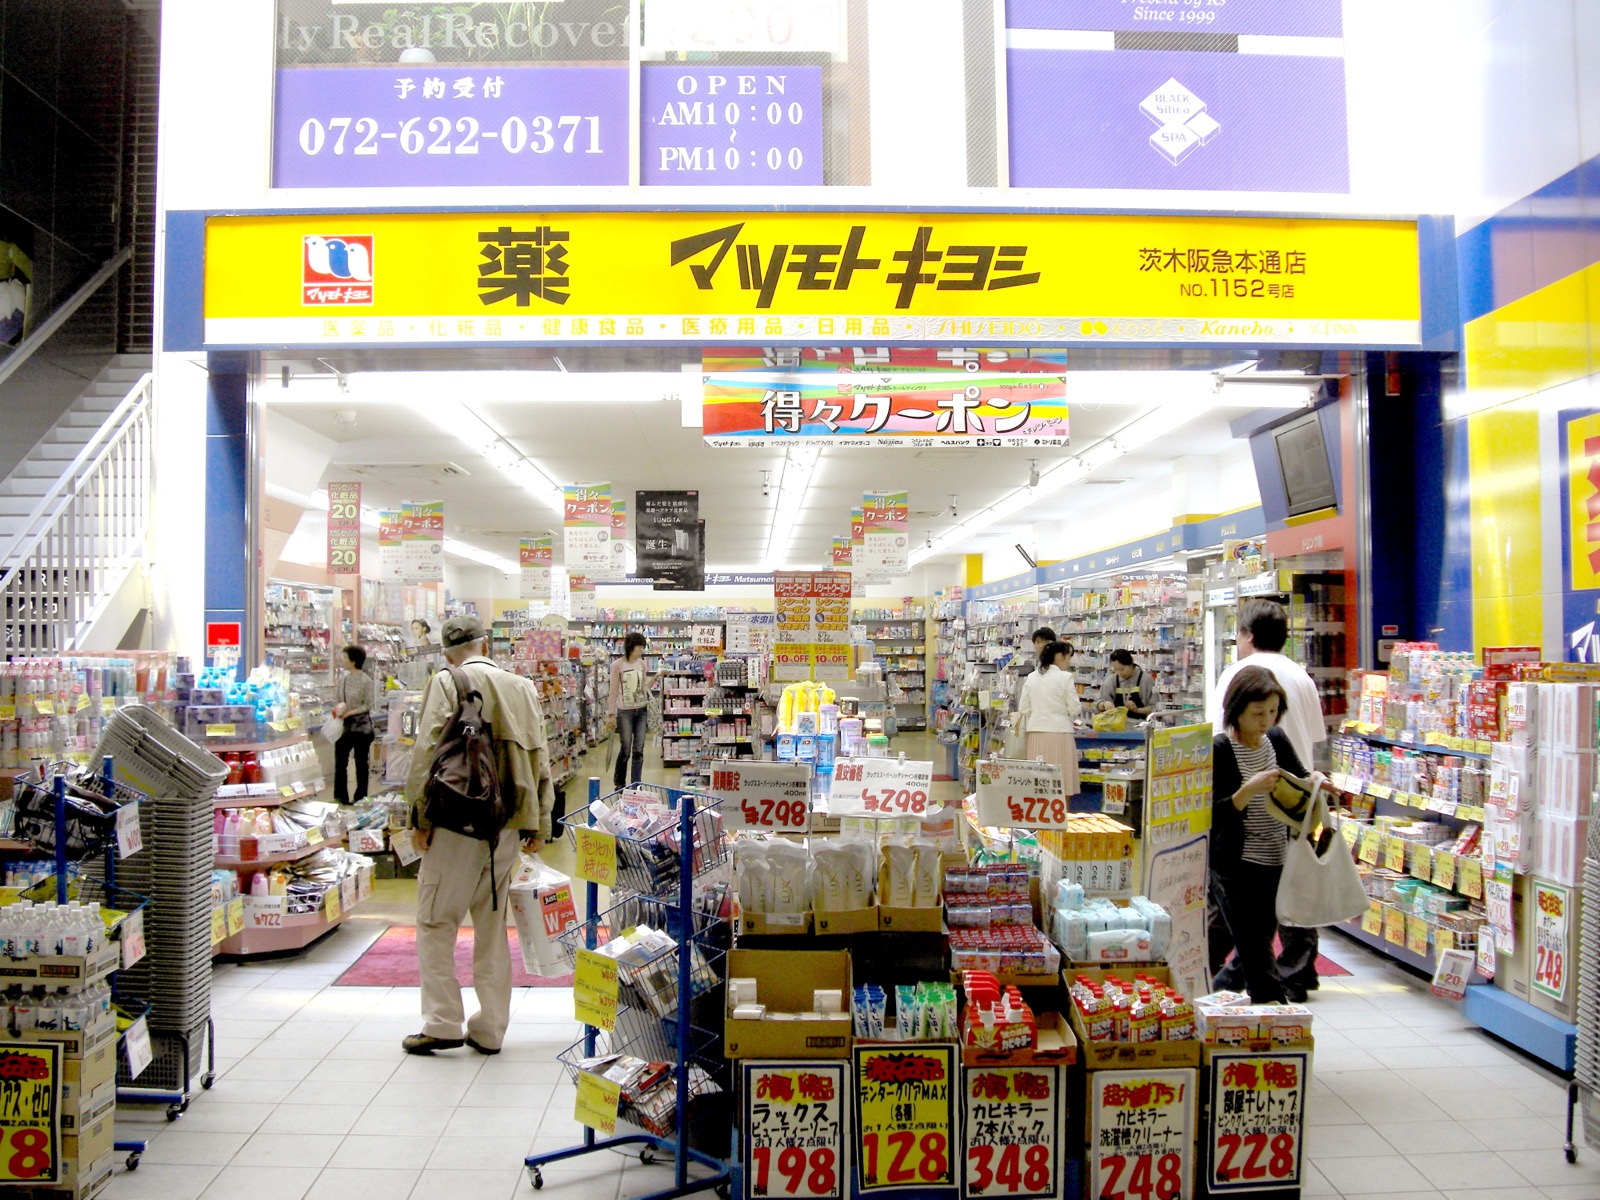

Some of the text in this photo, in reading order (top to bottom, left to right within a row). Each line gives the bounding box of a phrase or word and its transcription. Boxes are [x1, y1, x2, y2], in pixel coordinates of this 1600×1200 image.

[1133, 6, 1216, 25] Since 1999
[394, 75, 506, 100] 予約受付
[676, 75, 788, 96] OPEN
[1154, 93, 1191, 104] BLACK
[1155, 103, 1191, 115] Silica
[298, 114, 604, 156] 072-622-0371
[1160, 131, 1188, 144] SPA
[477, 222, 1040, 308] 薬 マツモトキヨシ
[1138, 247, 1308, 275] 茨木阪急本通店
[306, 287, 371, 303] マツモトキヨシ
[322, 318, 396, 337] 医薬品
[429, 318, 503, 337] 化粧品
[543, 318, 645, 336] 健康食品
[681, 318, 784, 336] 医療用品
[817, 318, 891, 336] 日用品
[936, 319, 1043, 336] SHISEIDO
[1199, 319, 1275, 336] Kanebo
[759, 385, 1031, 435] 得々クーポン
[575, 488, 600, 502] 得々
[874, 497, 897, 510] 得々
[330, 503, 358, 519] 20
[566, 503, 610, 514] クーポン
[866, 509, 907, 521] クーポン
[403, 519, 442, 529] クーポン
[330, 550, 358, 566] 20
[734, 576, 775, 584] Matsumot
[208, 646, 239, 655] SEOM
[1155, 740, 1209, 773] 得々クーポン
[712, 770, 741, 791] 期間限定
[834, 763, 864, 781] 激安価格
[1535, 945, 1563, 989] 248
[0, 1083, 51, 1119] アス・ゼロ
[753, 1103, 829, 1125] ラックス
[972, 1103, 1049, 1119] カビキラー
[1116, 1108, 1167, 1126] カビキラー
[976, 1120, 1044, 1138] 2本パック
[1100, 1126, 1183, 1147] 洗濯槽クリーナー
[0, 1128, 51, 1178] 8
[863, 1131, 948, 1182] 128
[1216, 1133, 1294, 1180] 228
[753, 1147, 836, 1195] 198
[968, 1144, 1050, 1193] 348
[1100, 1153, 1181, 1200] 248
